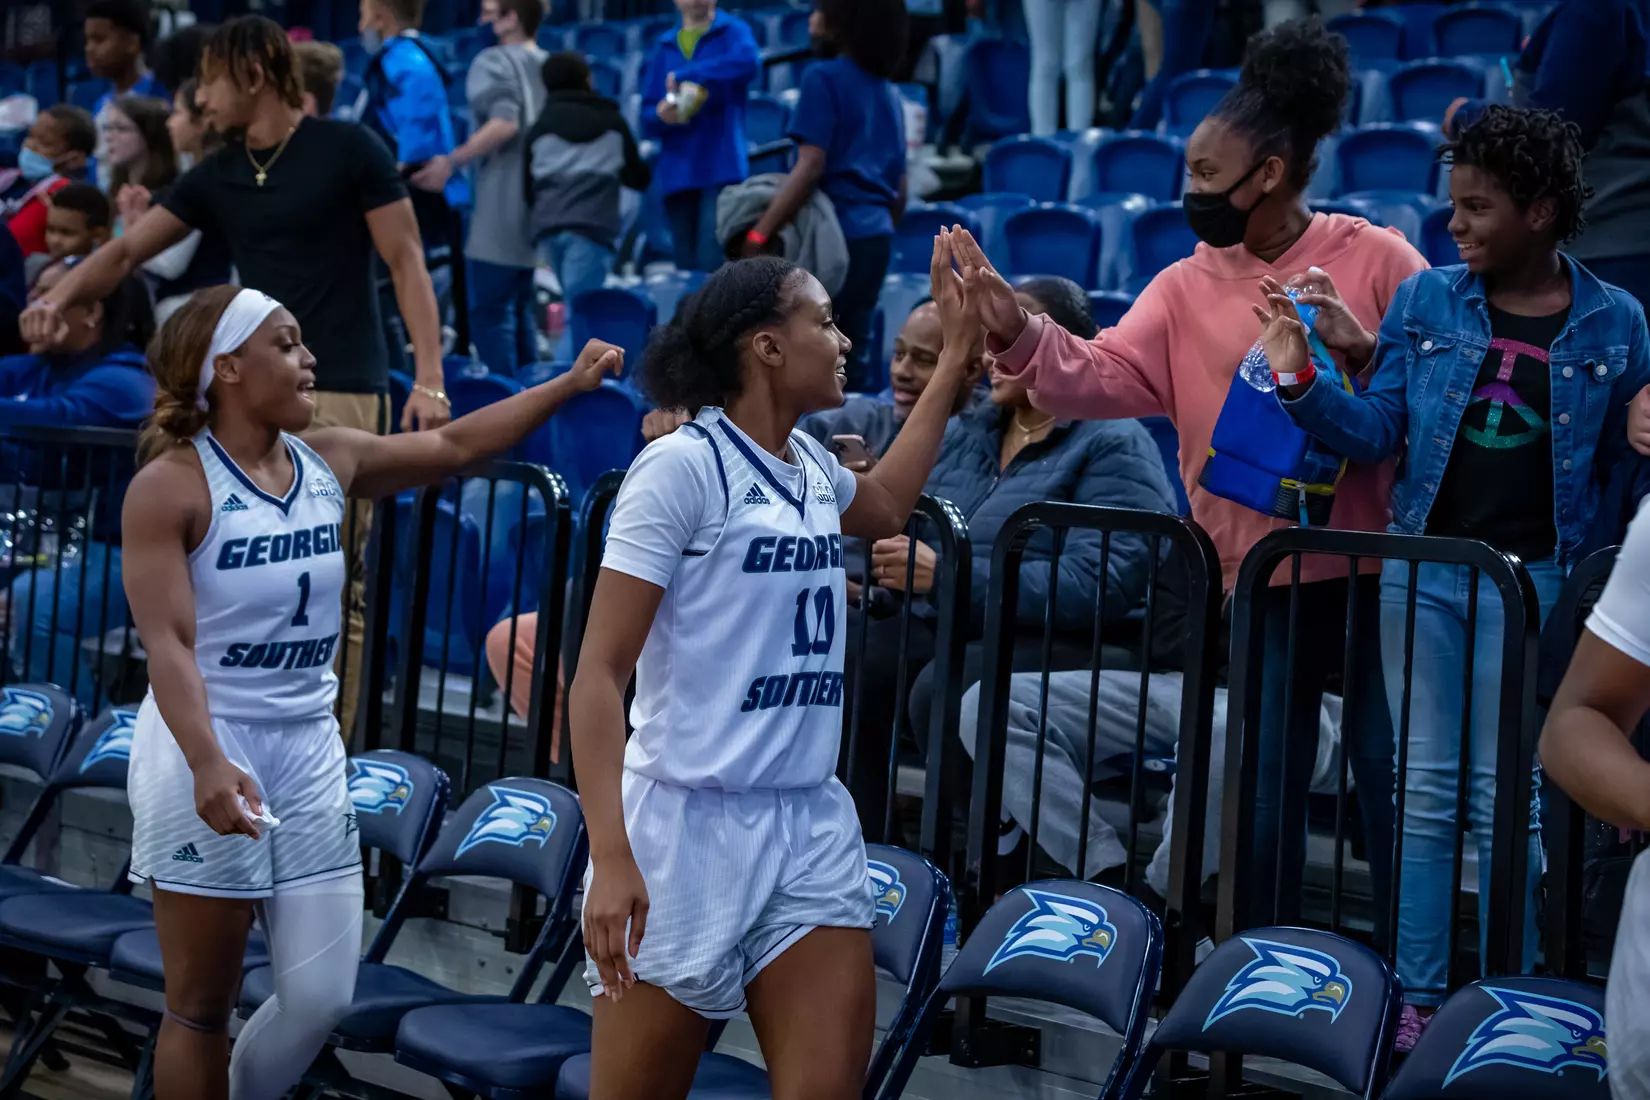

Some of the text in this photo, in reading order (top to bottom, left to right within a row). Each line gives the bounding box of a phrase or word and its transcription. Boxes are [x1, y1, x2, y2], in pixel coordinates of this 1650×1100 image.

[744, 495, 771, 505] adidas
[216, 522, 341, 571] GEORGI
[741, 532, 844, 574] GEORGI
[290, 571, 311, 627] 1
[791, 585, 835, 657] 10
[172, 854, 204, 864] adidas
